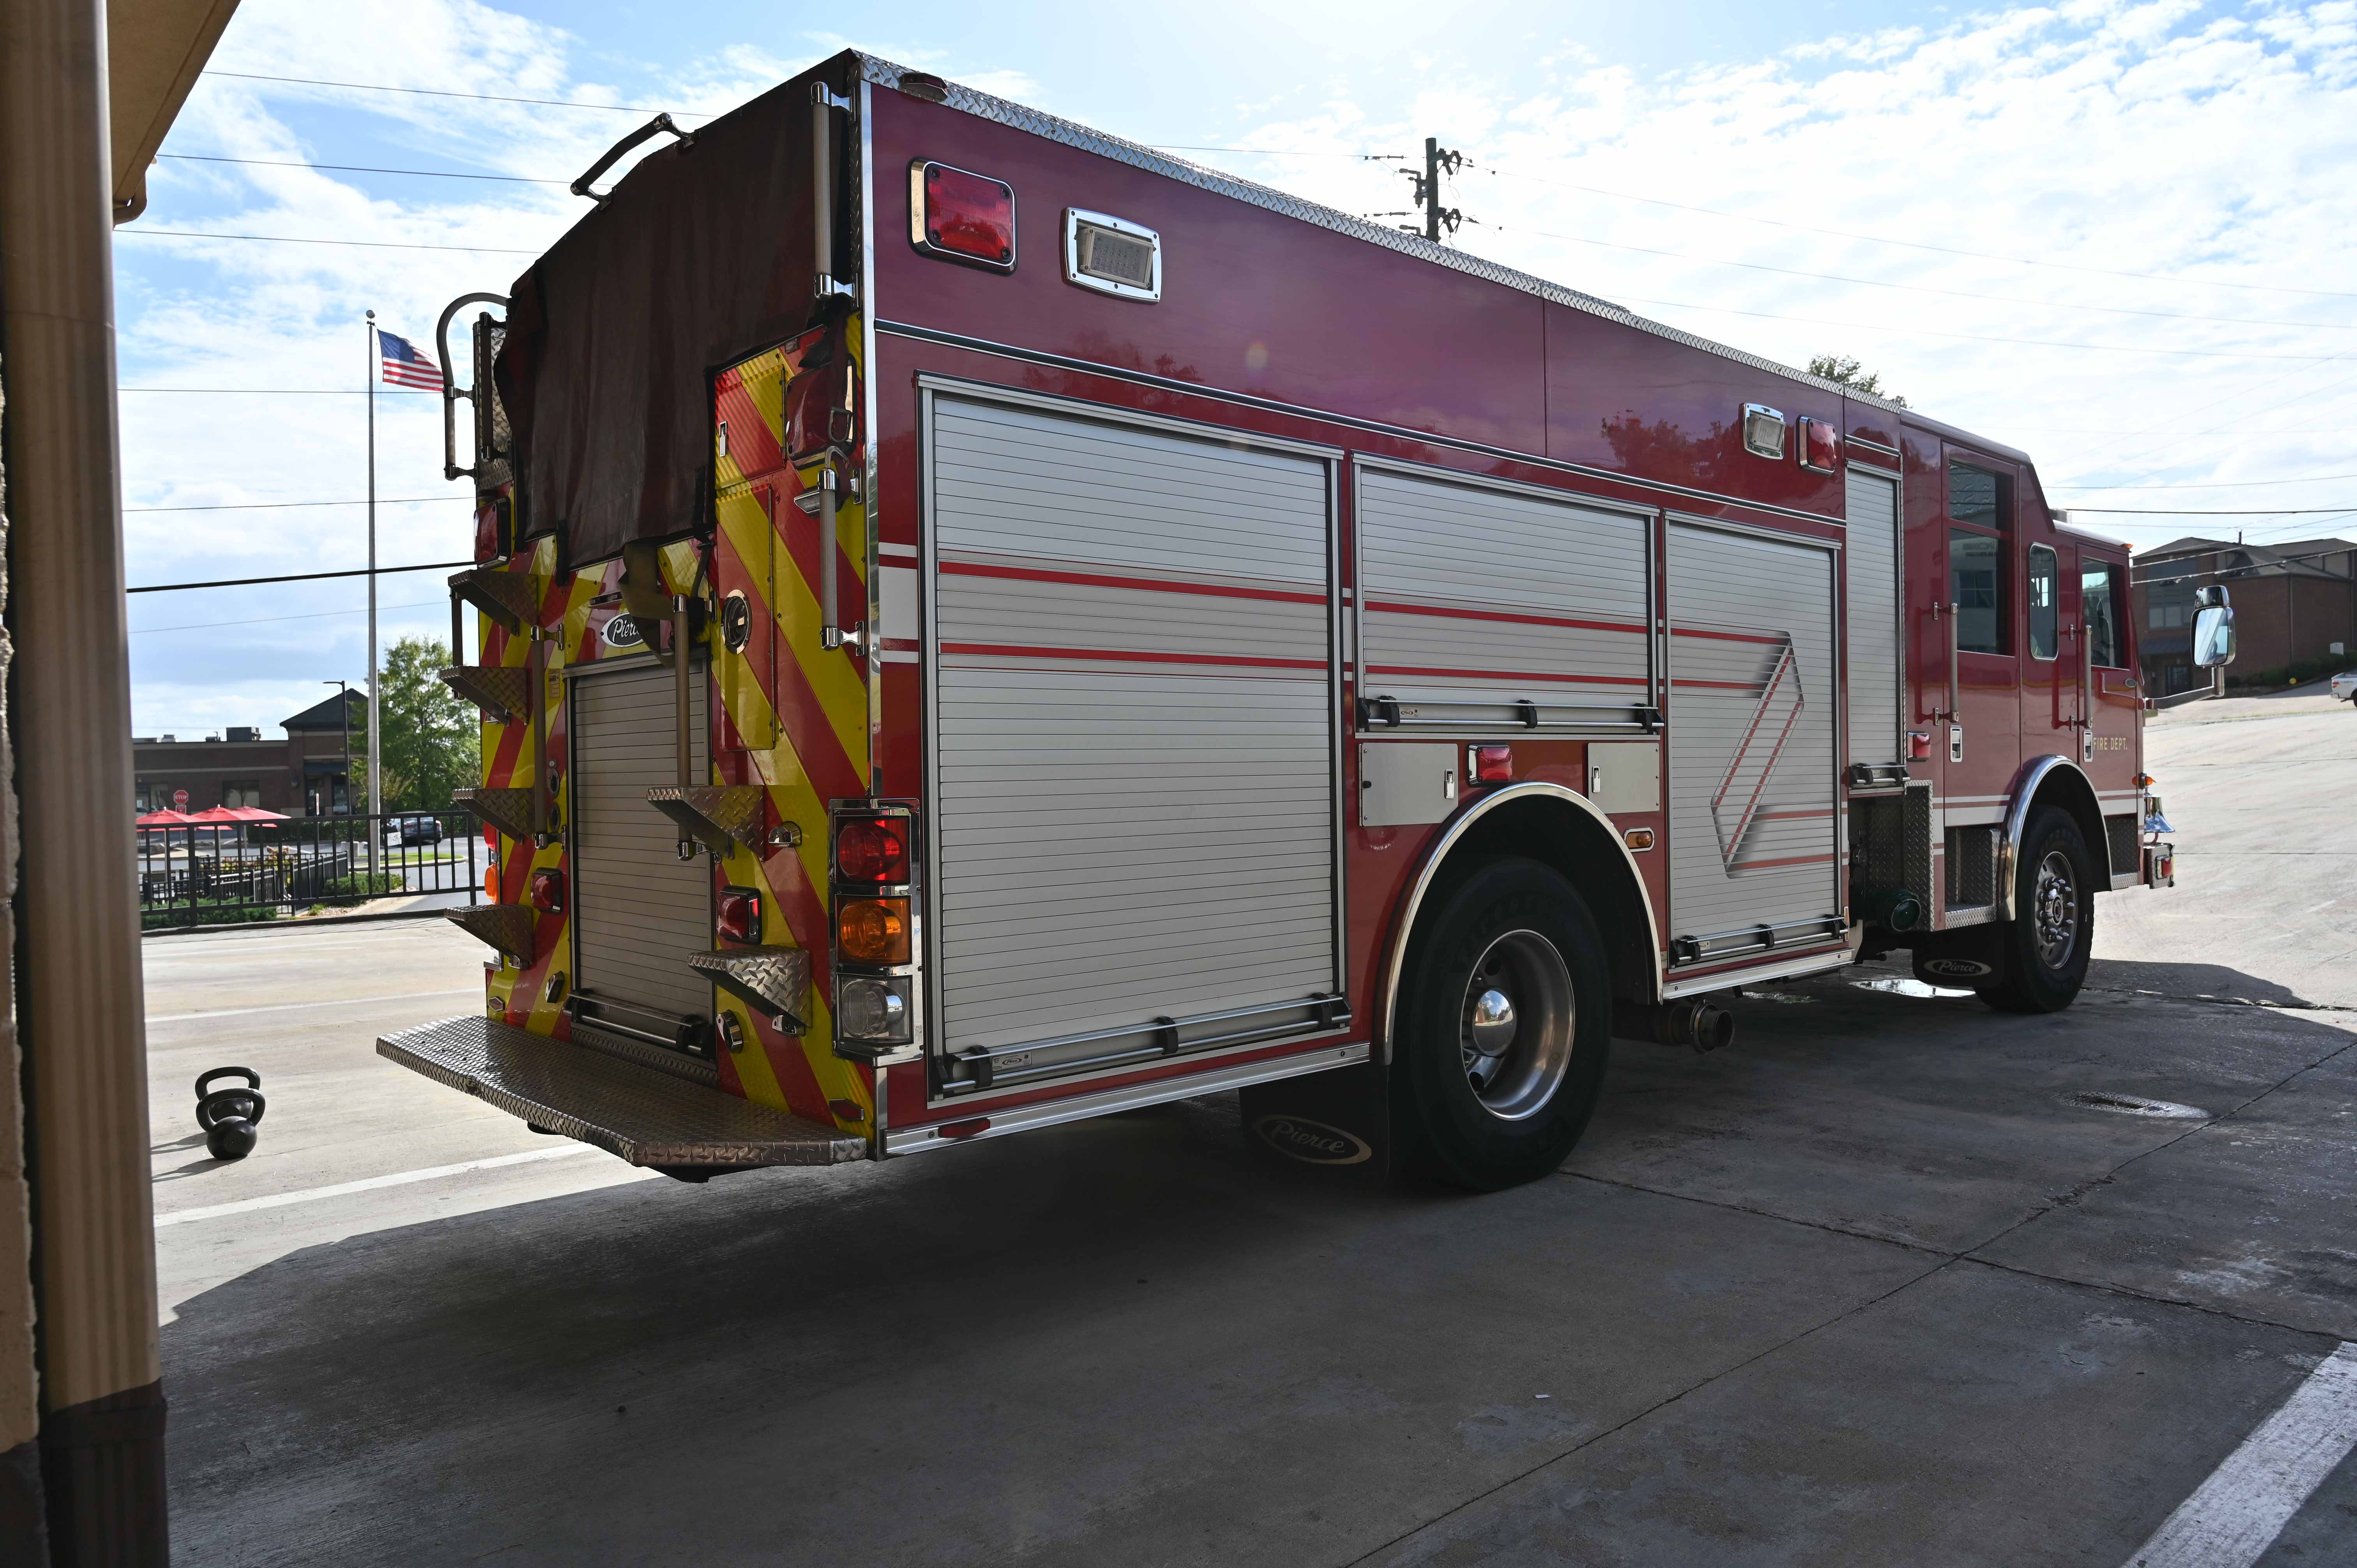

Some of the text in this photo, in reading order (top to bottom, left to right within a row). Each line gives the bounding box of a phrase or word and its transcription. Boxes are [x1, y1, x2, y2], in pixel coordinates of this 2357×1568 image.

[2093, 737, 2127, 750] FIRE DEPT.
[1939, 961, 1975, 972] Pierce
[1271, 1120, 1345, 1153] Pierce
